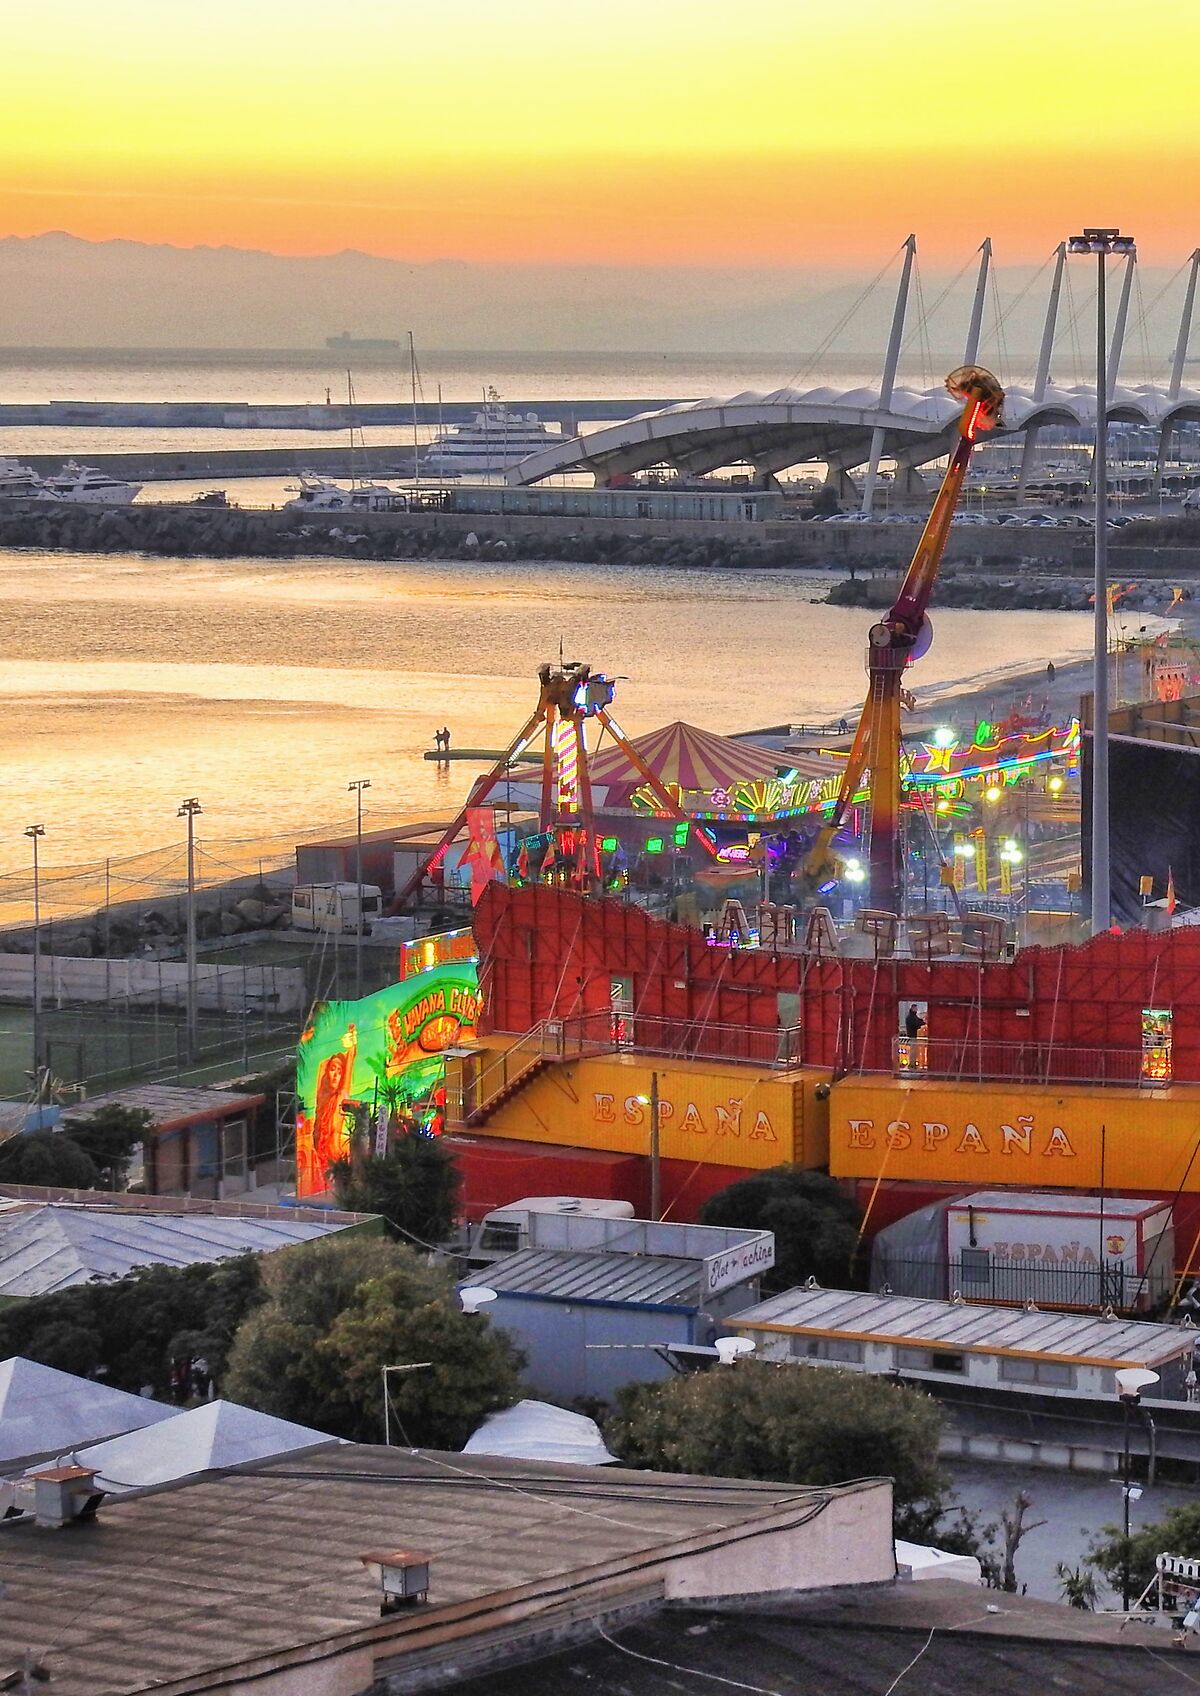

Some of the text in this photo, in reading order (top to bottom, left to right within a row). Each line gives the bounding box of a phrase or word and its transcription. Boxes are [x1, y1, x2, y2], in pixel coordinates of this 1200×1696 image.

[403, 988, 446, 1038] HAVANA
[450, 986, 477, 1021] CLUB
[592, 1093, 778, 1142] ESPAÑA
[847, 1114, 1077, 1157] ESPAÑA
[710, 1259, 729, 1288] Slot
[993, 1240, 1099, 1266] ESPAÑA
